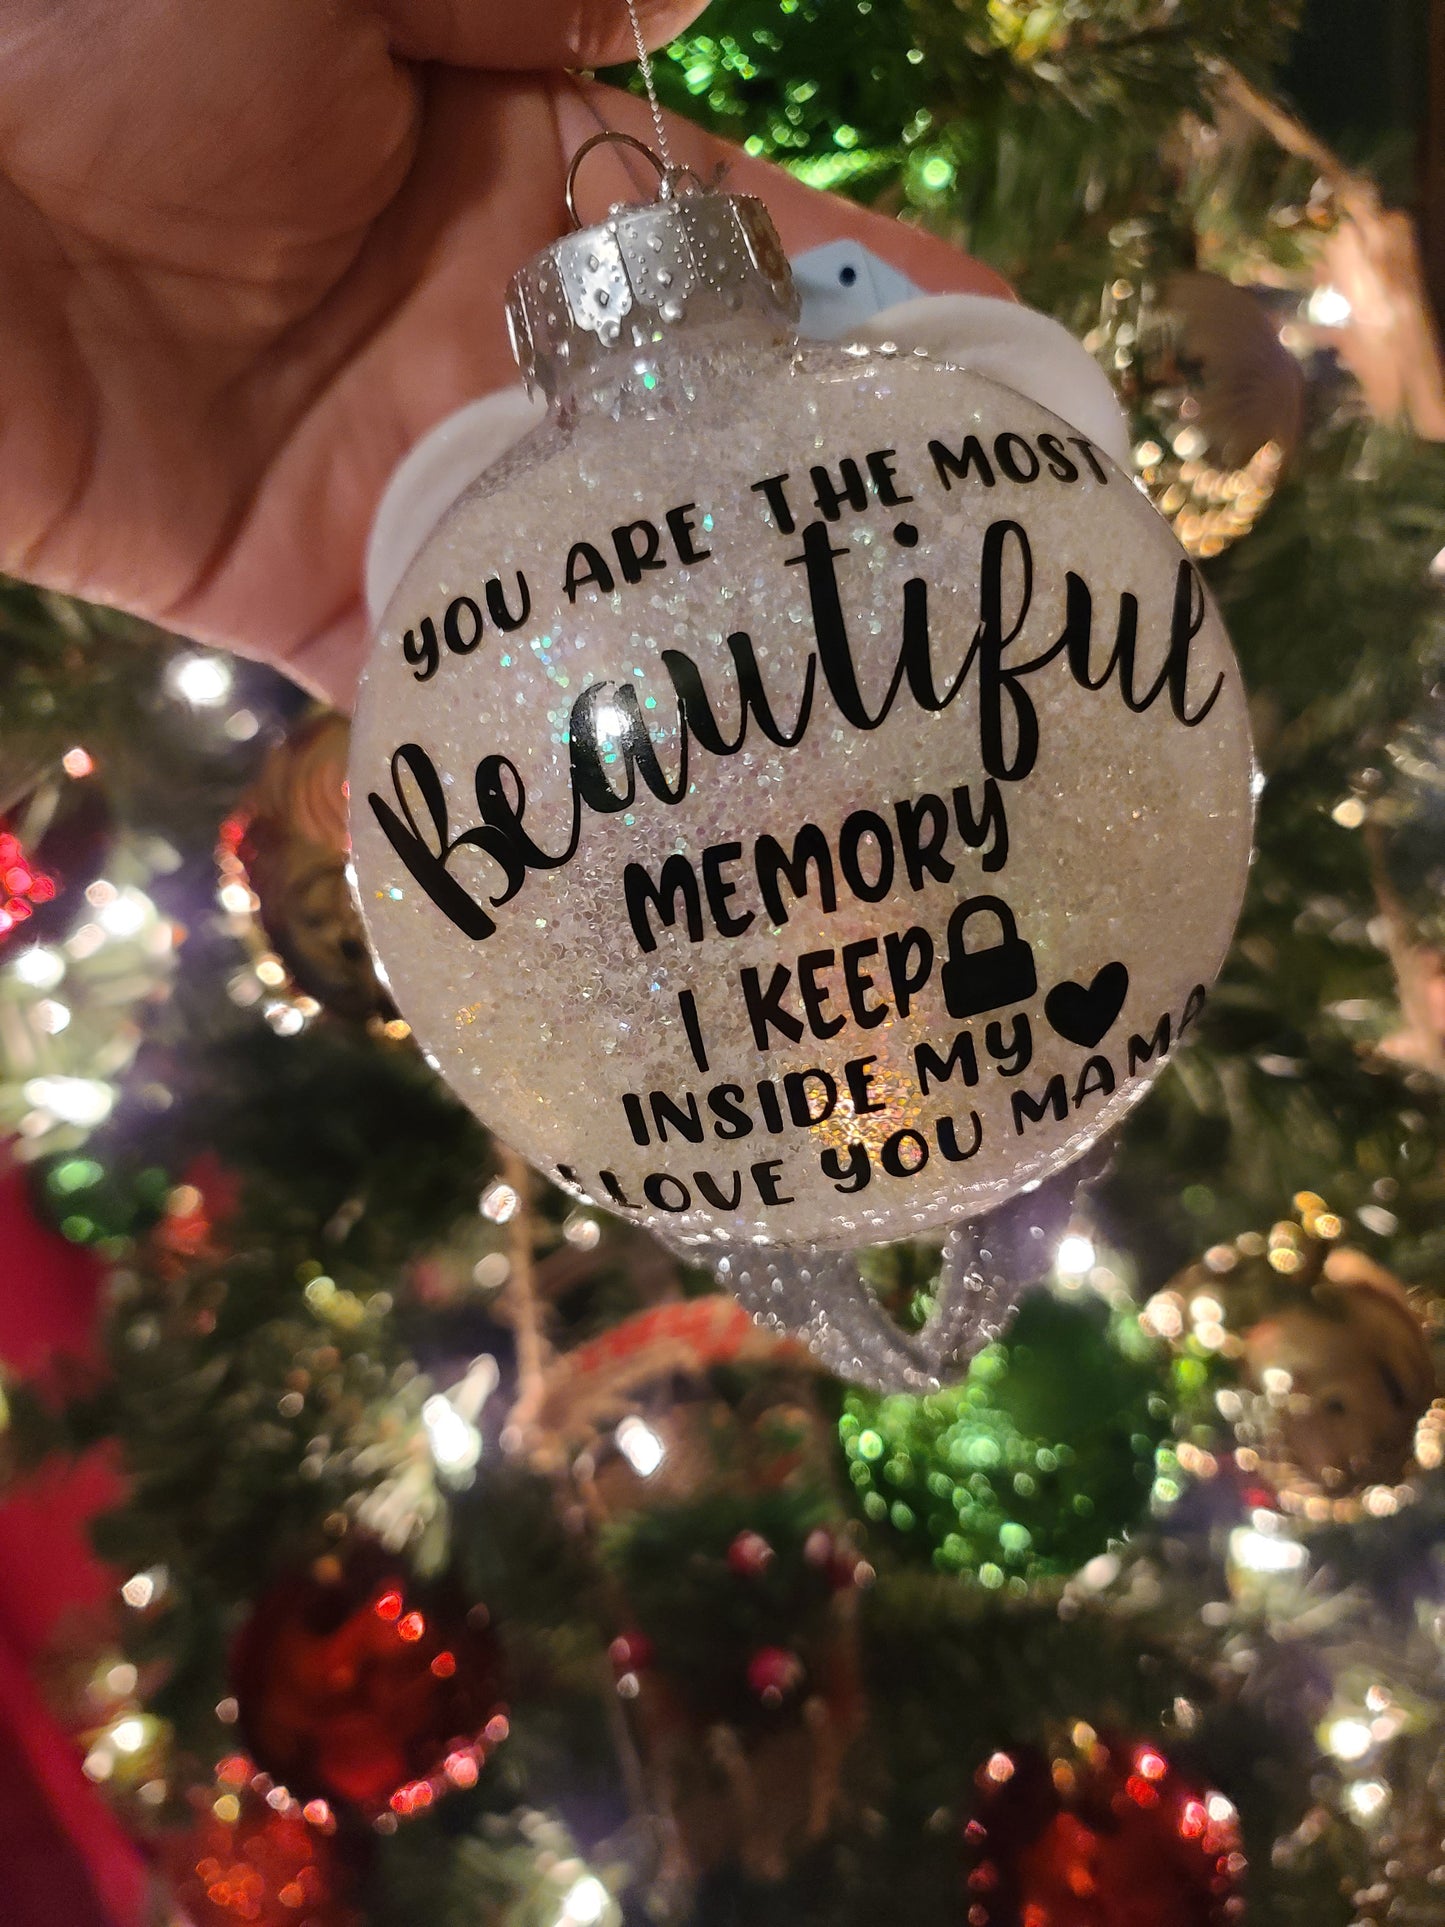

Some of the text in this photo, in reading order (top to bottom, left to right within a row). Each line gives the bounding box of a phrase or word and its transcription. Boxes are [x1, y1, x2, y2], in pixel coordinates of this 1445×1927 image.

[562, 502, 711, 604] ARE
[750, 449, 914, 535] THE
[928, 432, 1108, 491] MOST
[623, 778, 1010, 953] MEMORY
[621, 1013, 1033, 1146] INSIDE MY
[678, 925, 935, 1072] I KEEP
[600, 1159, 796, 1213] LOVE
[1011, 983, 1207, 1136] MAMA
